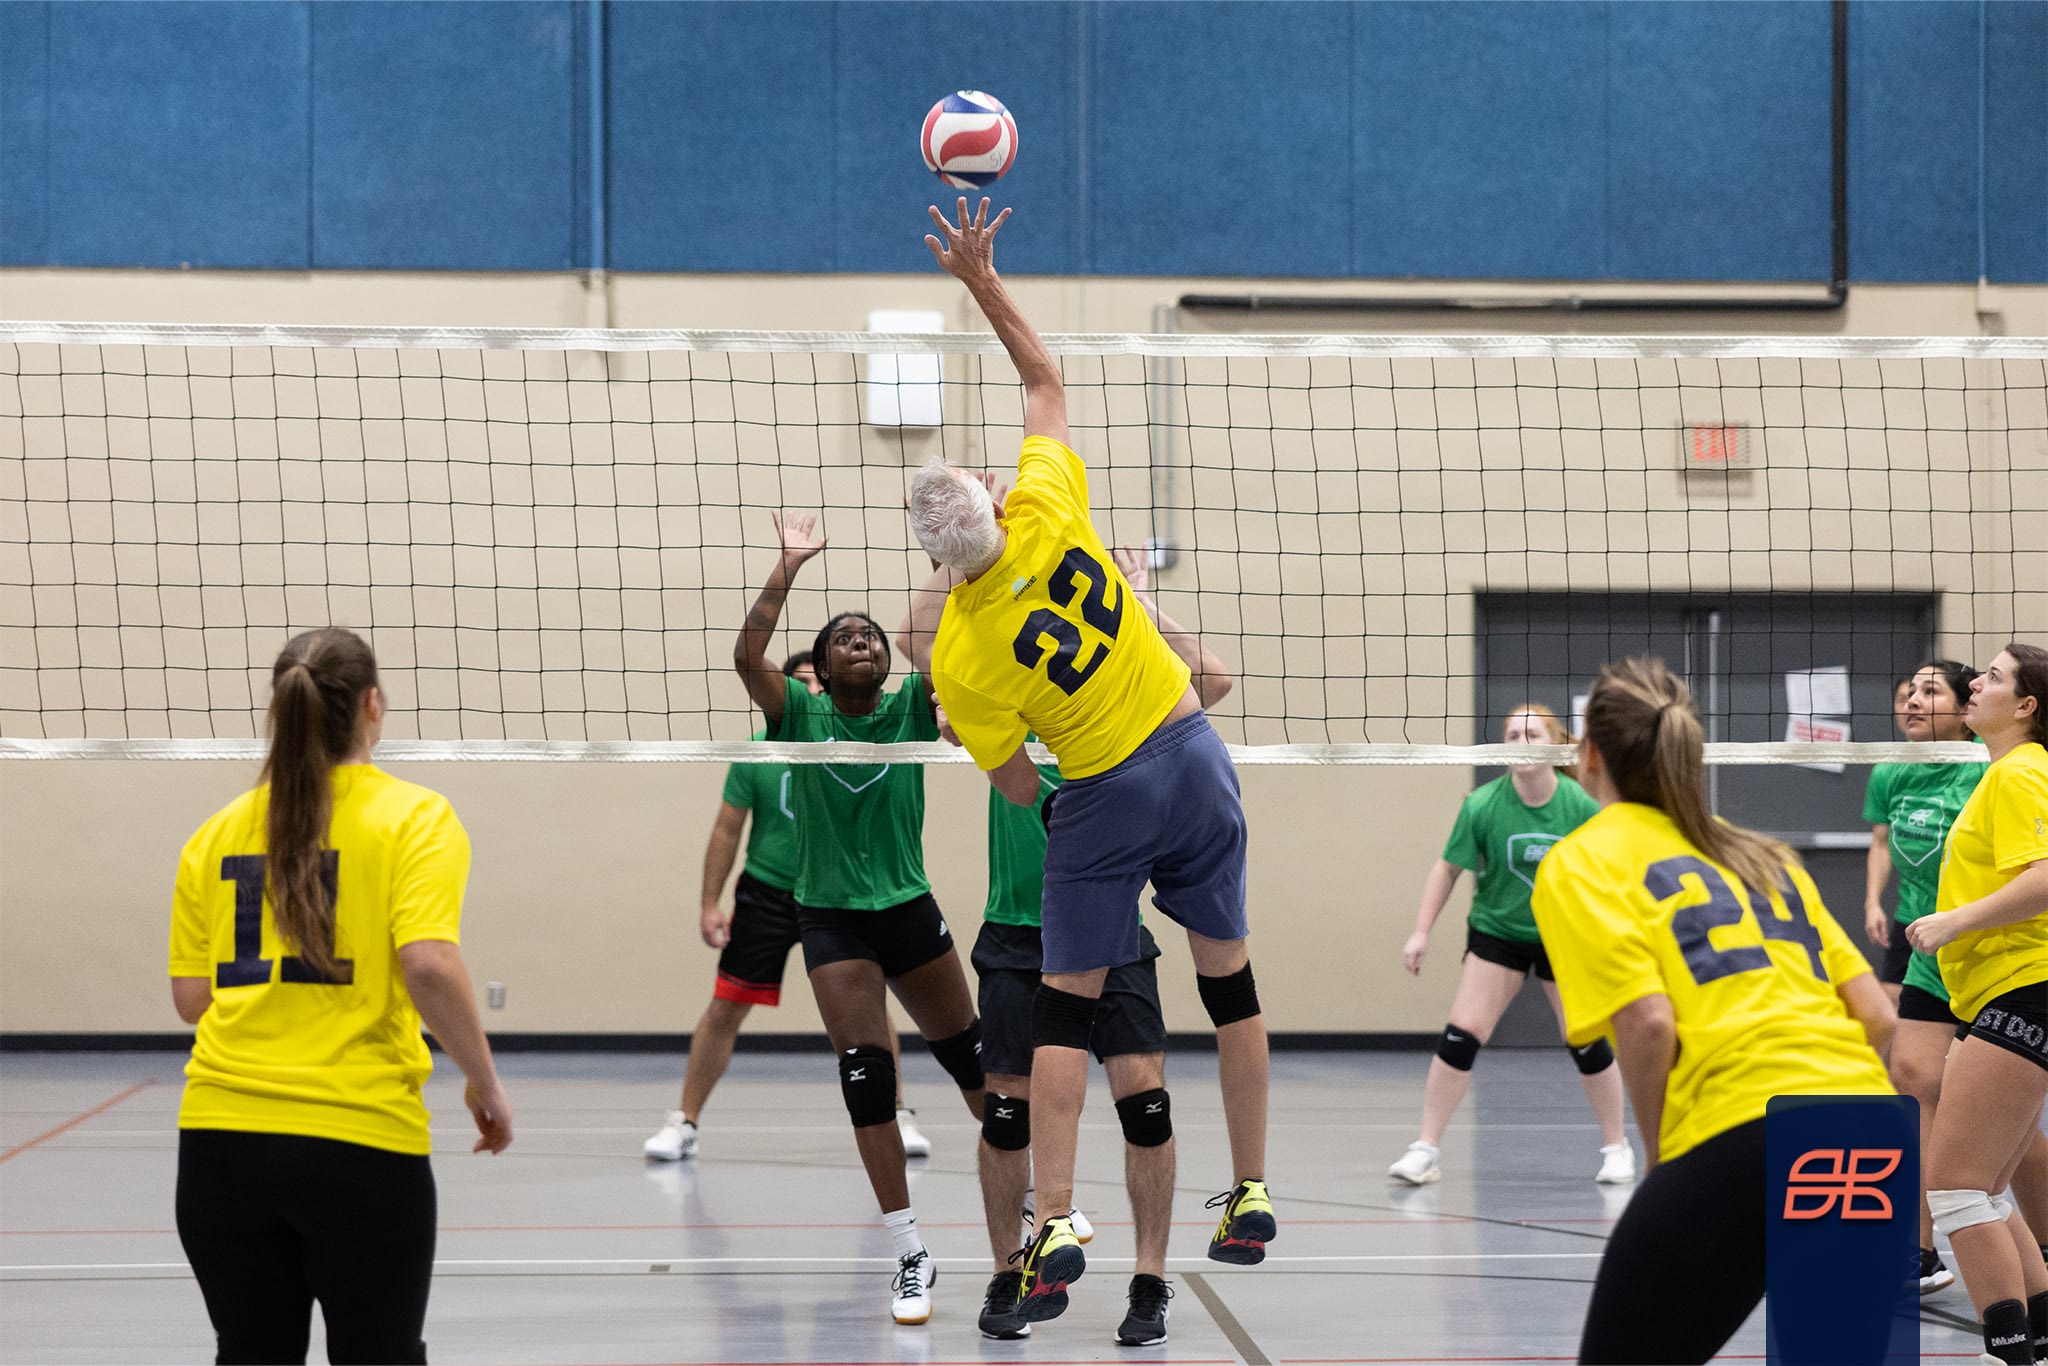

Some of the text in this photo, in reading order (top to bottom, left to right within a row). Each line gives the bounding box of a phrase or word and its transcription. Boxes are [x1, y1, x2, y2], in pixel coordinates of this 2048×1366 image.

[1013, 547, 1123, 697] 22
[1644, 855, 1830, 986] 24
[1975, 1008, 2008, 1030] ST
